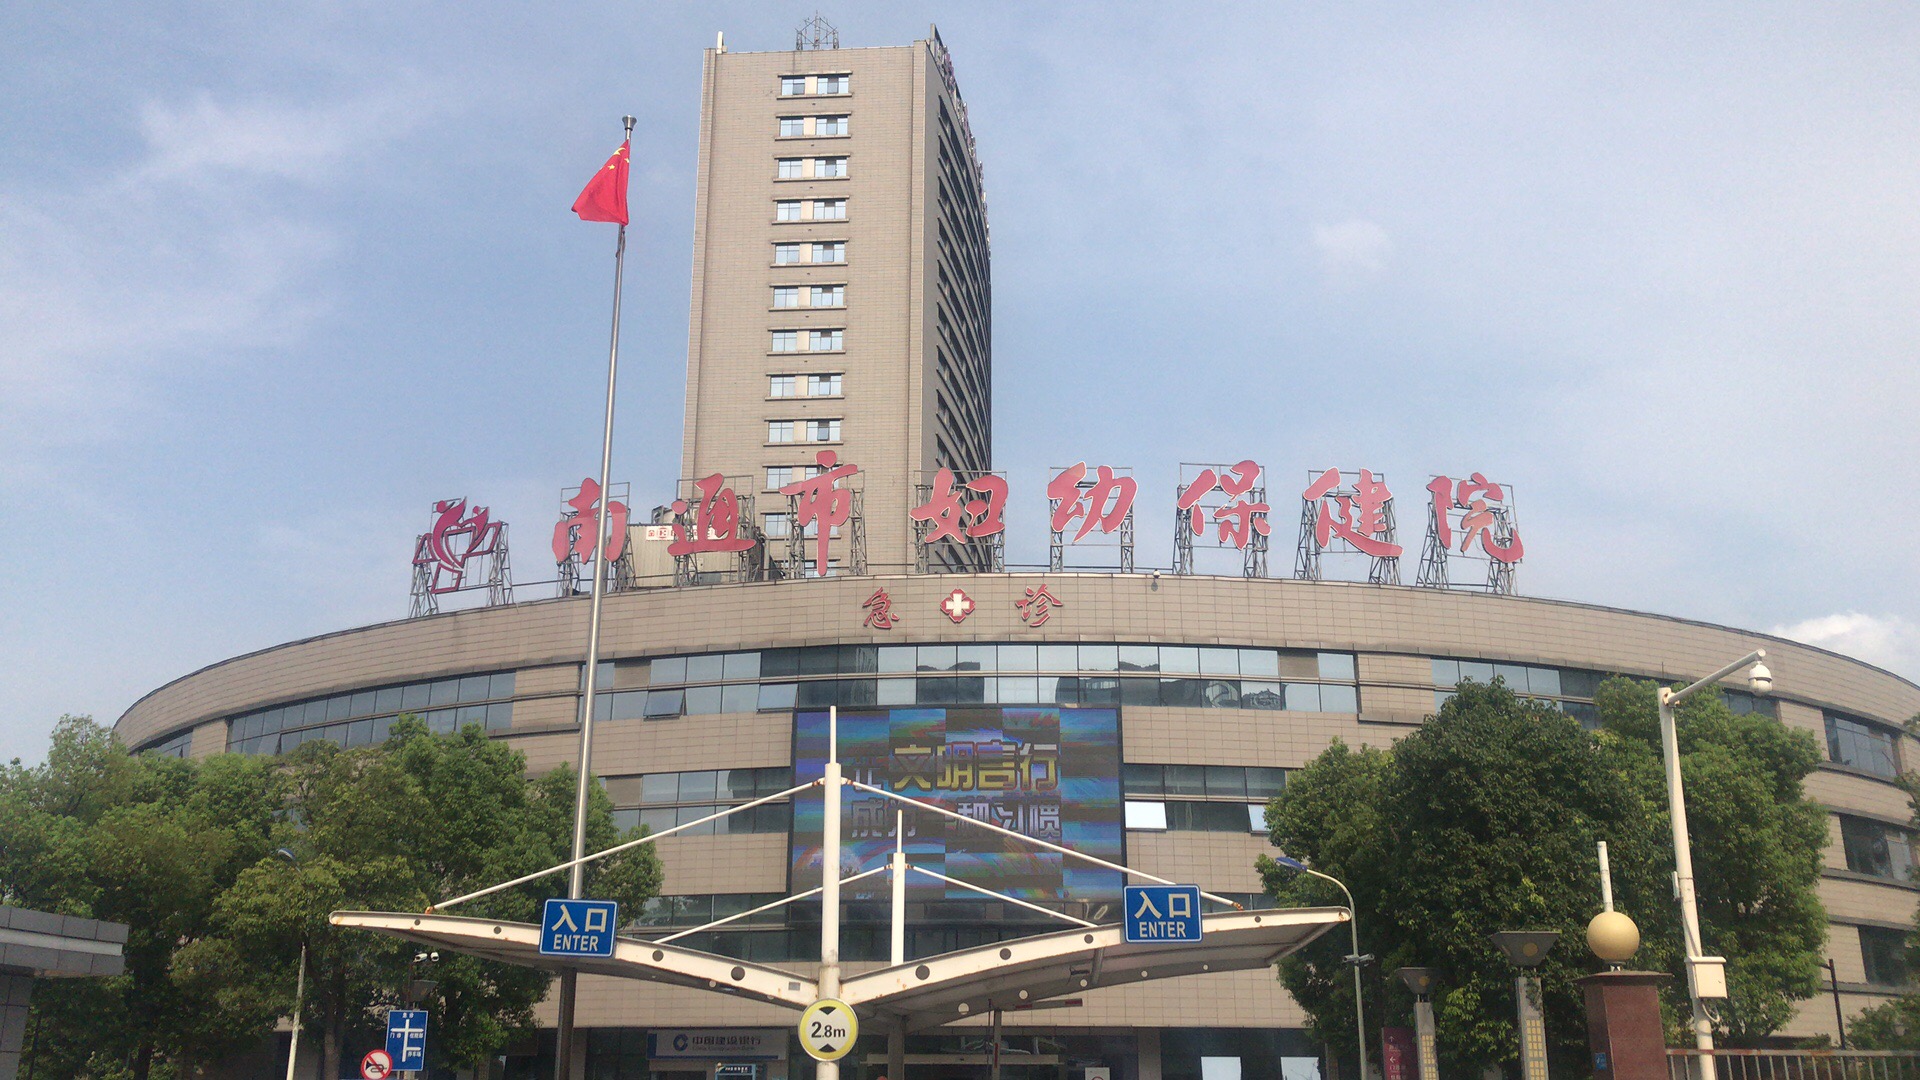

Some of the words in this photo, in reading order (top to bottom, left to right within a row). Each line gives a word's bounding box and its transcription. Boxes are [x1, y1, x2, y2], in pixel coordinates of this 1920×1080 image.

[552, 450, 1524, 576] 南通市妇幼保健院
[1134, 890, 1192, 919] 入口
[551, 903, 608, 933] 入口
[1138, 921, 1187, 938] ENTER
[553, 933, 599, 952] ENTER
[811, 1021, 846, 1038] 2.8m
[692, 1035, 762, 1046] 中国建设银行
